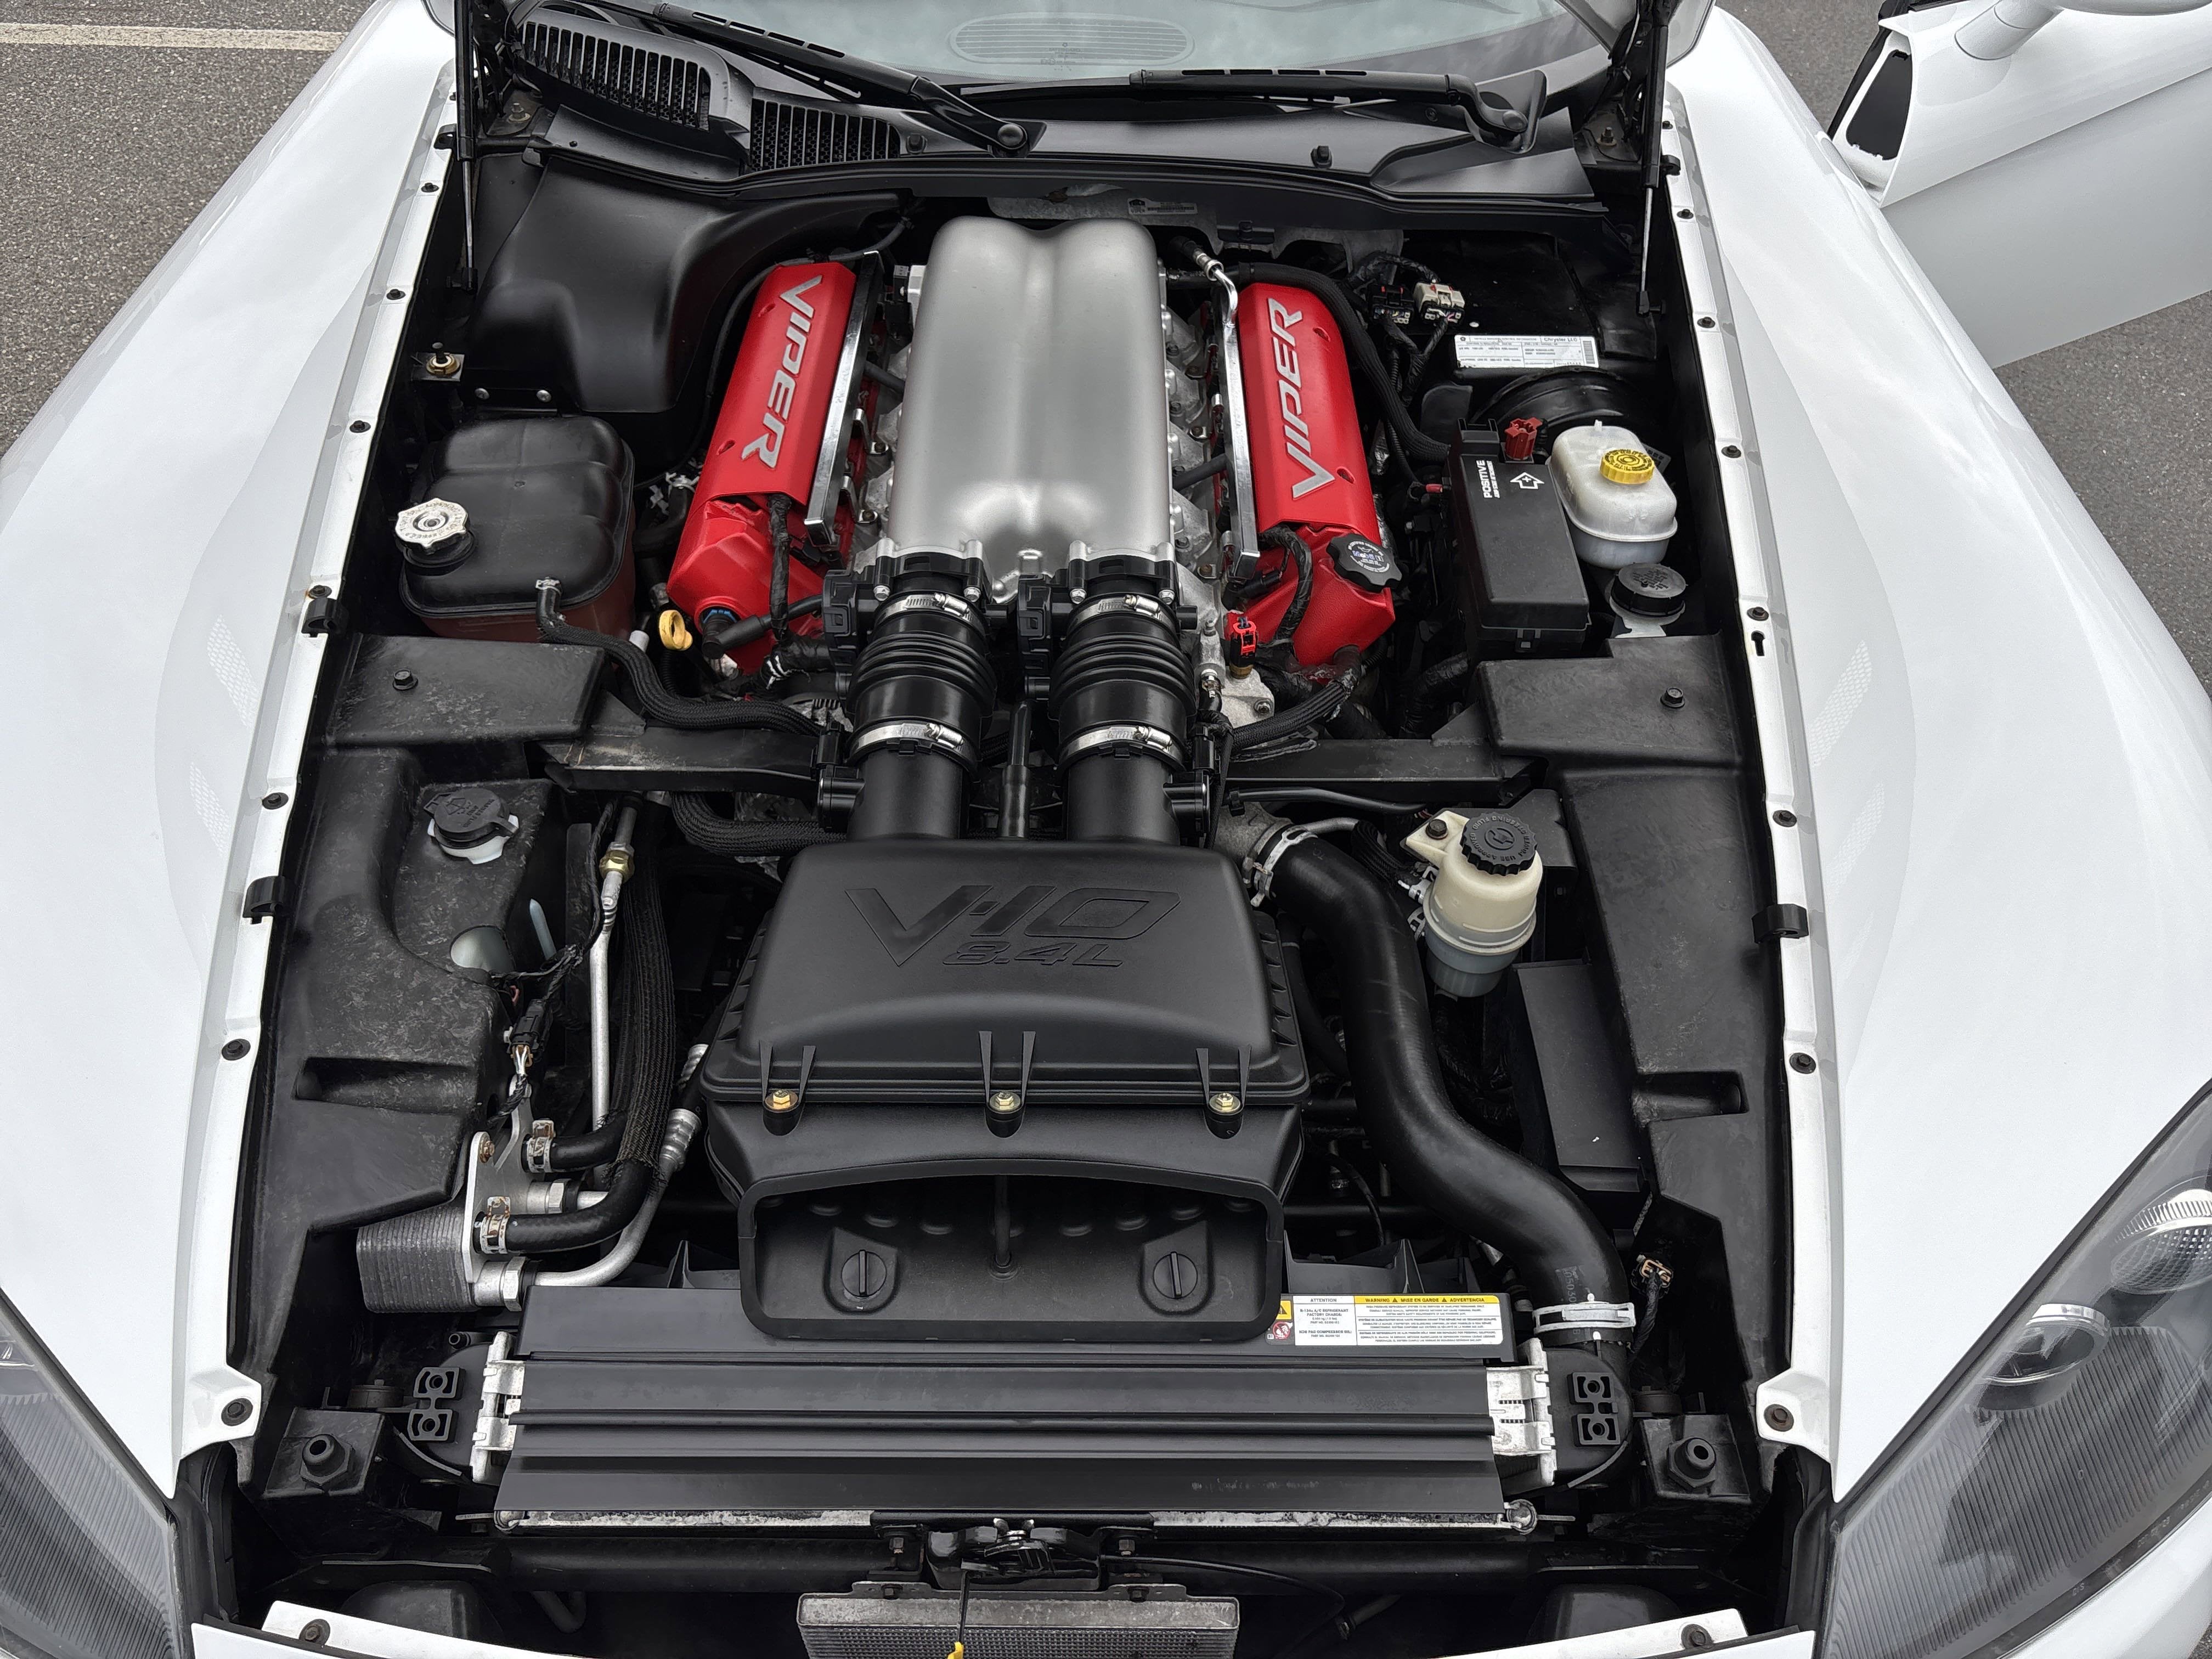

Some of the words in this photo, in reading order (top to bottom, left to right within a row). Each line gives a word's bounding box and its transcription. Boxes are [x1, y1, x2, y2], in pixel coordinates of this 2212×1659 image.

[741, 274, 823, 469] VIPER
[1267, 297, 1335, 500] VIPER
[1476, 460, 1492, 498] POSITIVE
[1352, 550, 1375, 560] Mobil
[1472, 816, 1490, 830] FLUID
[1492, 815, 1526, 834] STEERING
[943, 941, 1123, 967] 8.4L
